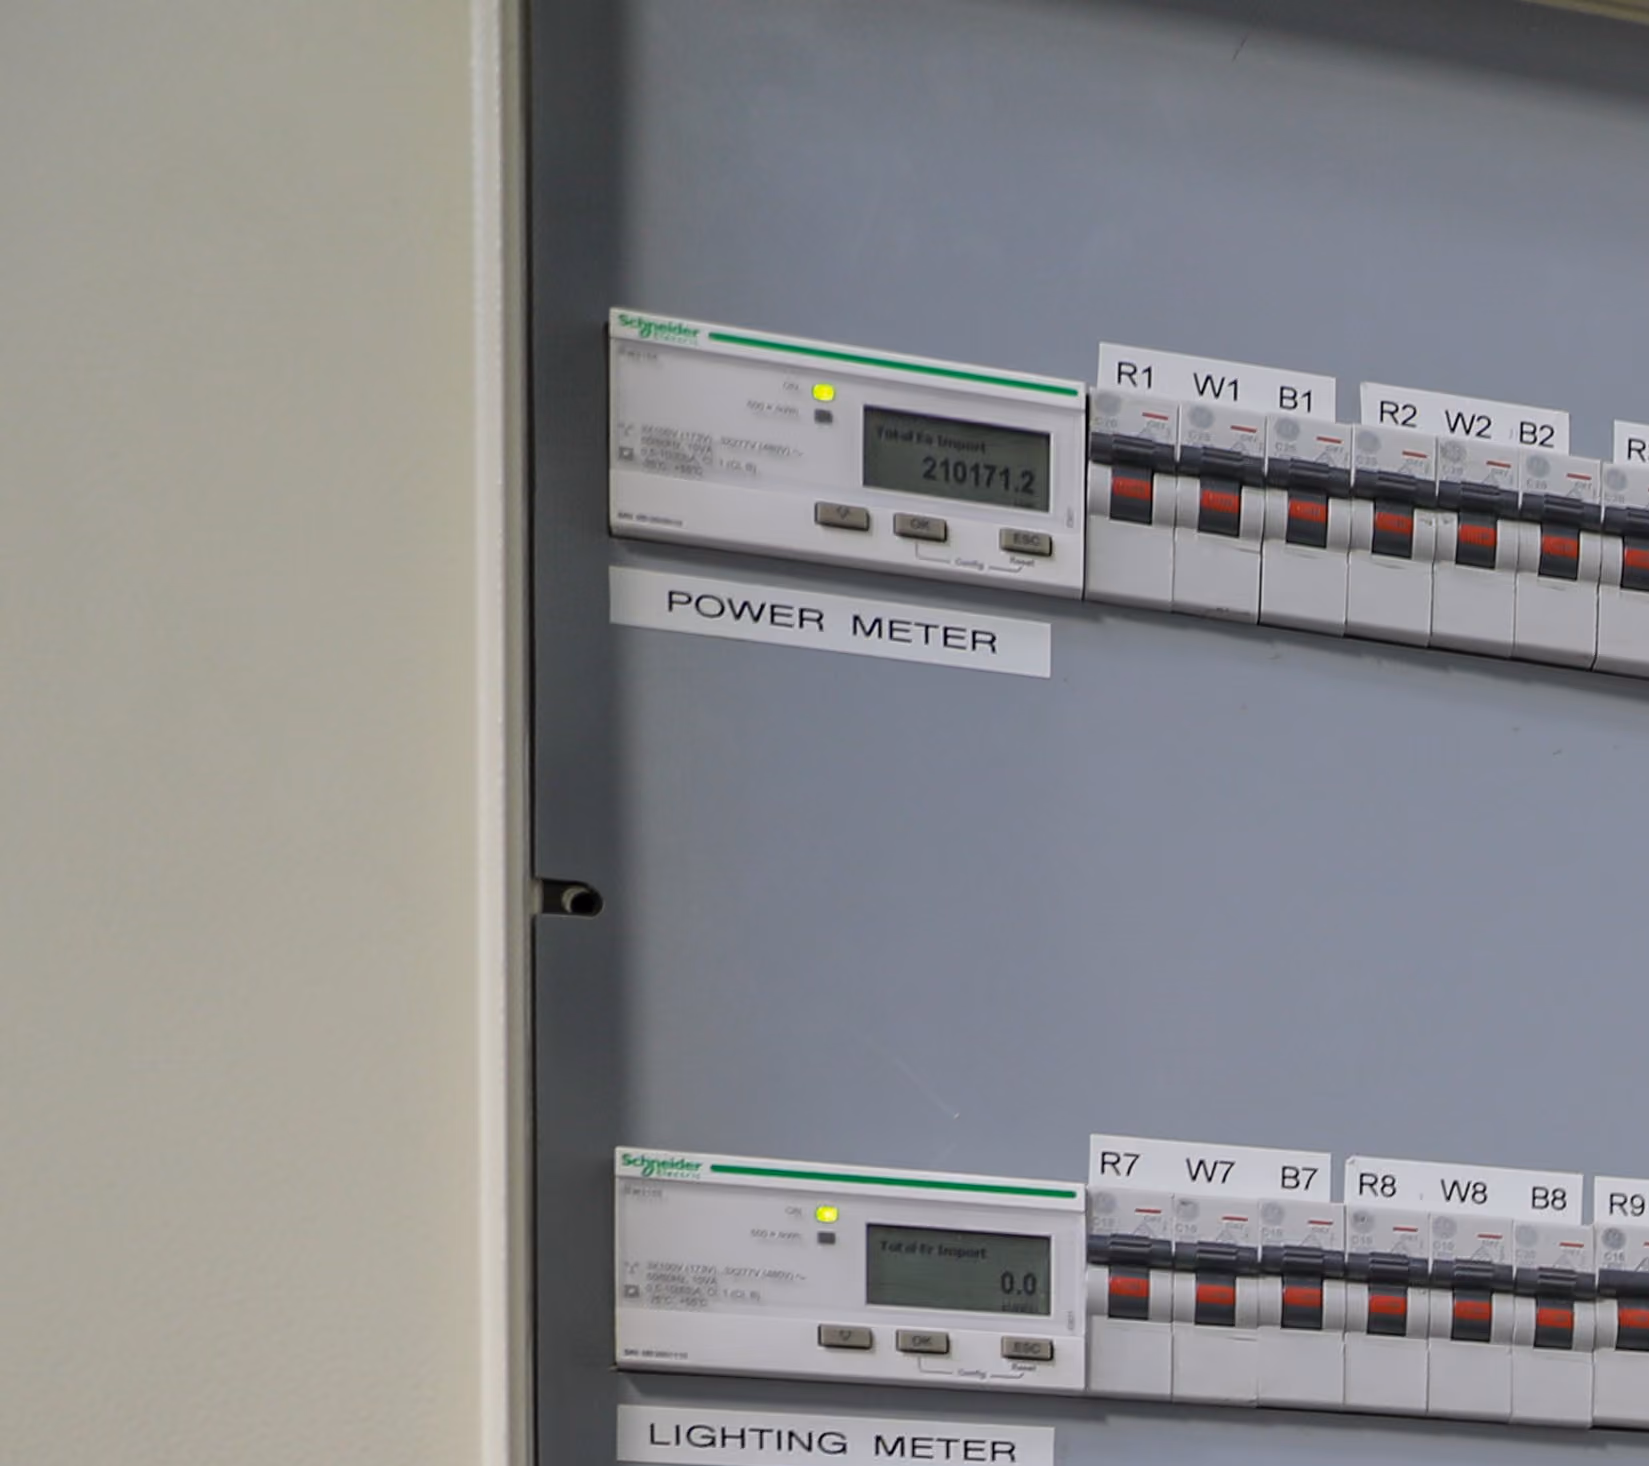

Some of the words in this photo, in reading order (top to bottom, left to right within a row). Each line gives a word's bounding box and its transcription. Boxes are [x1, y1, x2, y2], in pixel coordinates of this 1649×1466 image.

[618, 313, 700, 339] Schneider
[1117, 361, 1152, 389] R1
[1193, 372, 1238, 402] W1
[1279, 385, 1312, 413] B1
[1379, 400, 1417, 428] R2
[1444, 409, 1492, 439] W2
[1519, 421, 1555, 448] B2
[921, 455, 1036, 496] 210171.2
[667, 590, 824, 632] POWER
[850, 614, 998, 659] METER
[621, 1153, 702, 1177] Schneider
[1100, 1151, 1140, 1177] R7
[1185, 1158, 1235, 1184] W7
[1281, 1165, 1318, 1191] B7
[1359, 1172, 1397, 1198] R8
[1440, 1179, 1488, 1205] W8
[1531, 1186, 1567, 1211] B8
[1609, 1192, 1646, 1217] R9
[1001, 1270, 1037, 1296] 0.0
[911, 1334, 933, 1348] OK
[1012, 1341, 1041, 1356] ESC
[649, 1422, 847, 1455] LIGHTING
[874, 1434, 1016, 1463] METER
